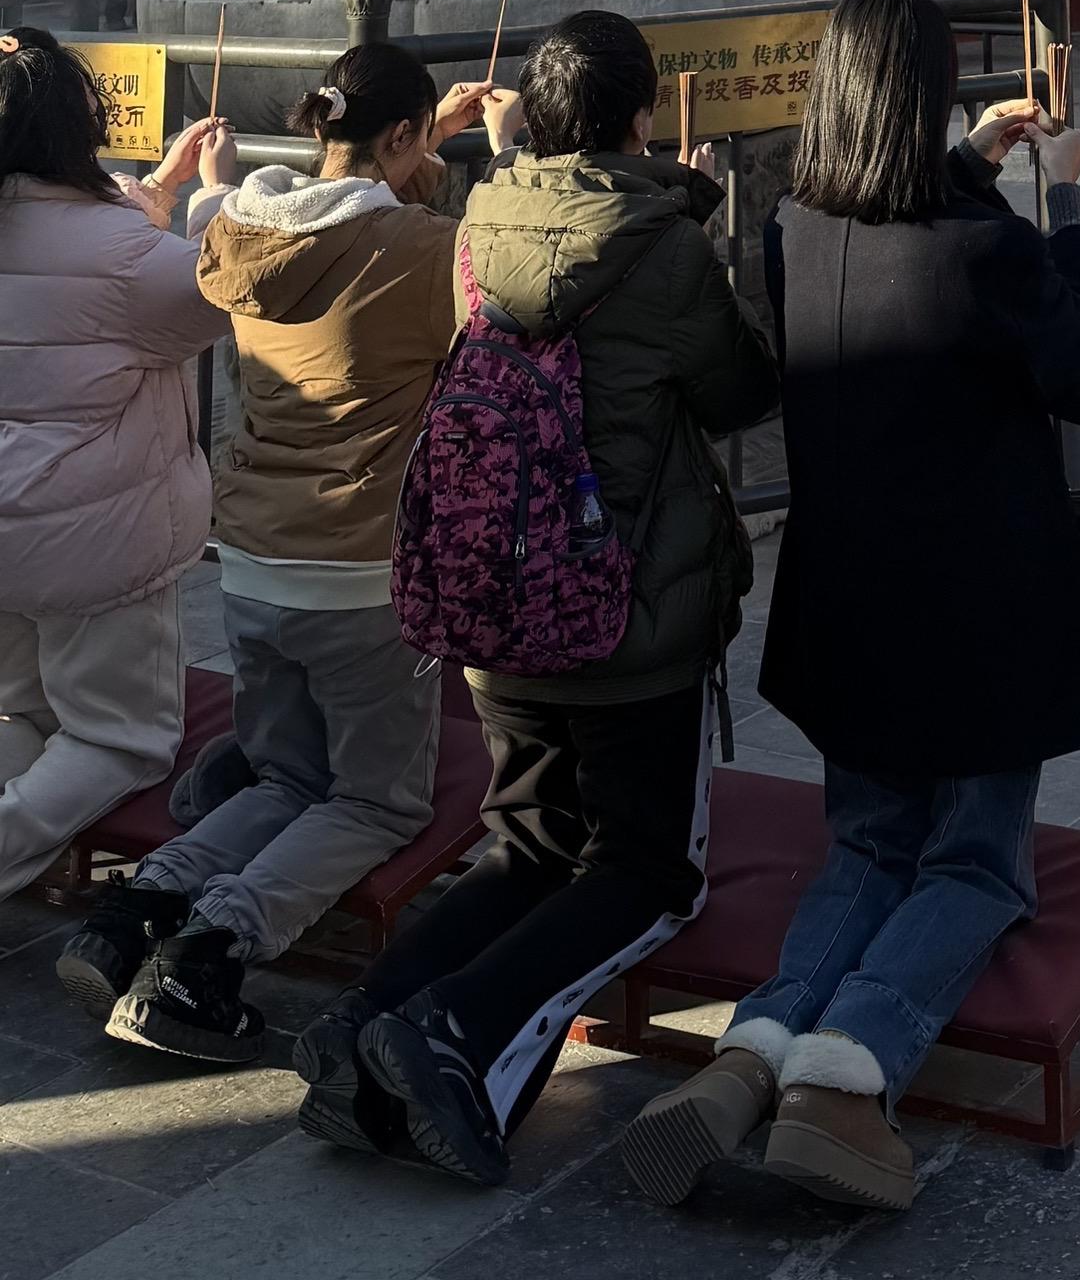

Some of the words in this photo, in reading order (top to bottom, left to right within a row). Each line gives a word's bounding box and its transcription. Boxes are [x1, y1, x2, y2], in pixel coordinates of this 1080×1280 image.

[658, 47, 737, 76] 保护文物
[655, 69, 811, 109] 请投香及投
